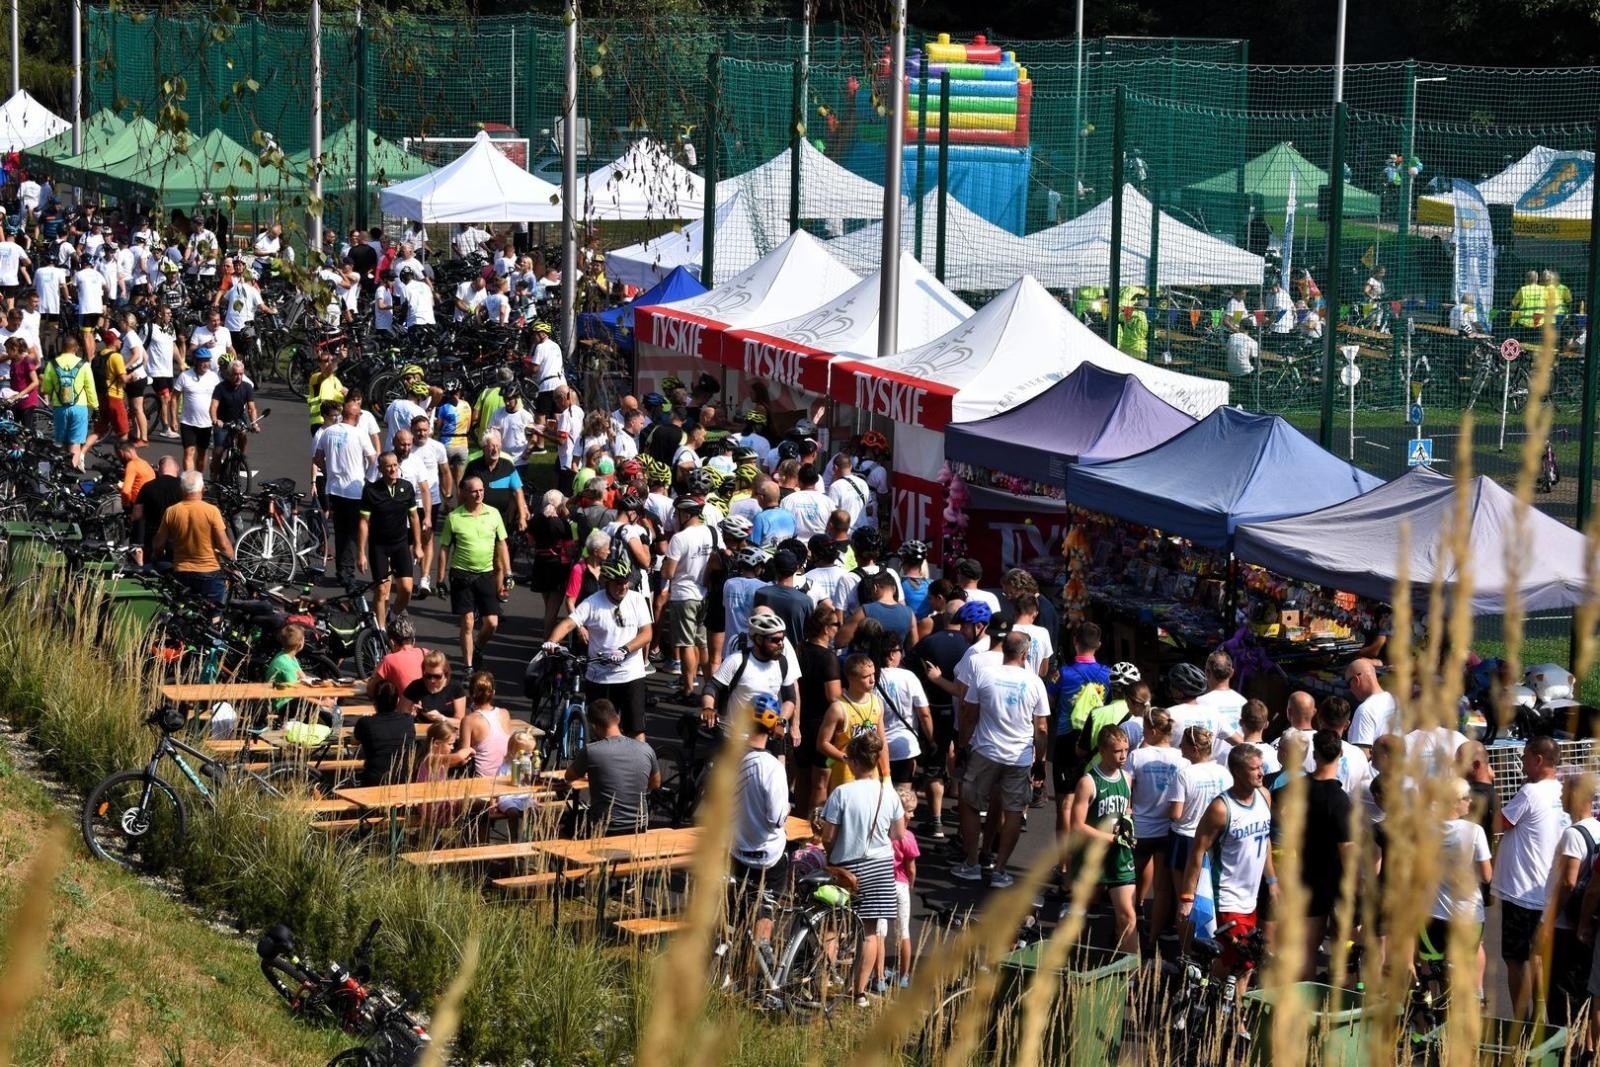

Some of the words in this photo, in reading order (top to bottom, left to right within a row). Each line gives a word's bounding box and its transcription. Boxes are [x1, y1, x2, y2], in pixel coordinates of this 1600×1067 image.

[651, 311, 707, 358] TYSKIE
[742, 337, 808, 391] TYSKIE
[853, 370, 928, 427] TYSKIE
[988, 522, 1067, 573] TY
[1232, 819, 1271, 840] DALLAS
